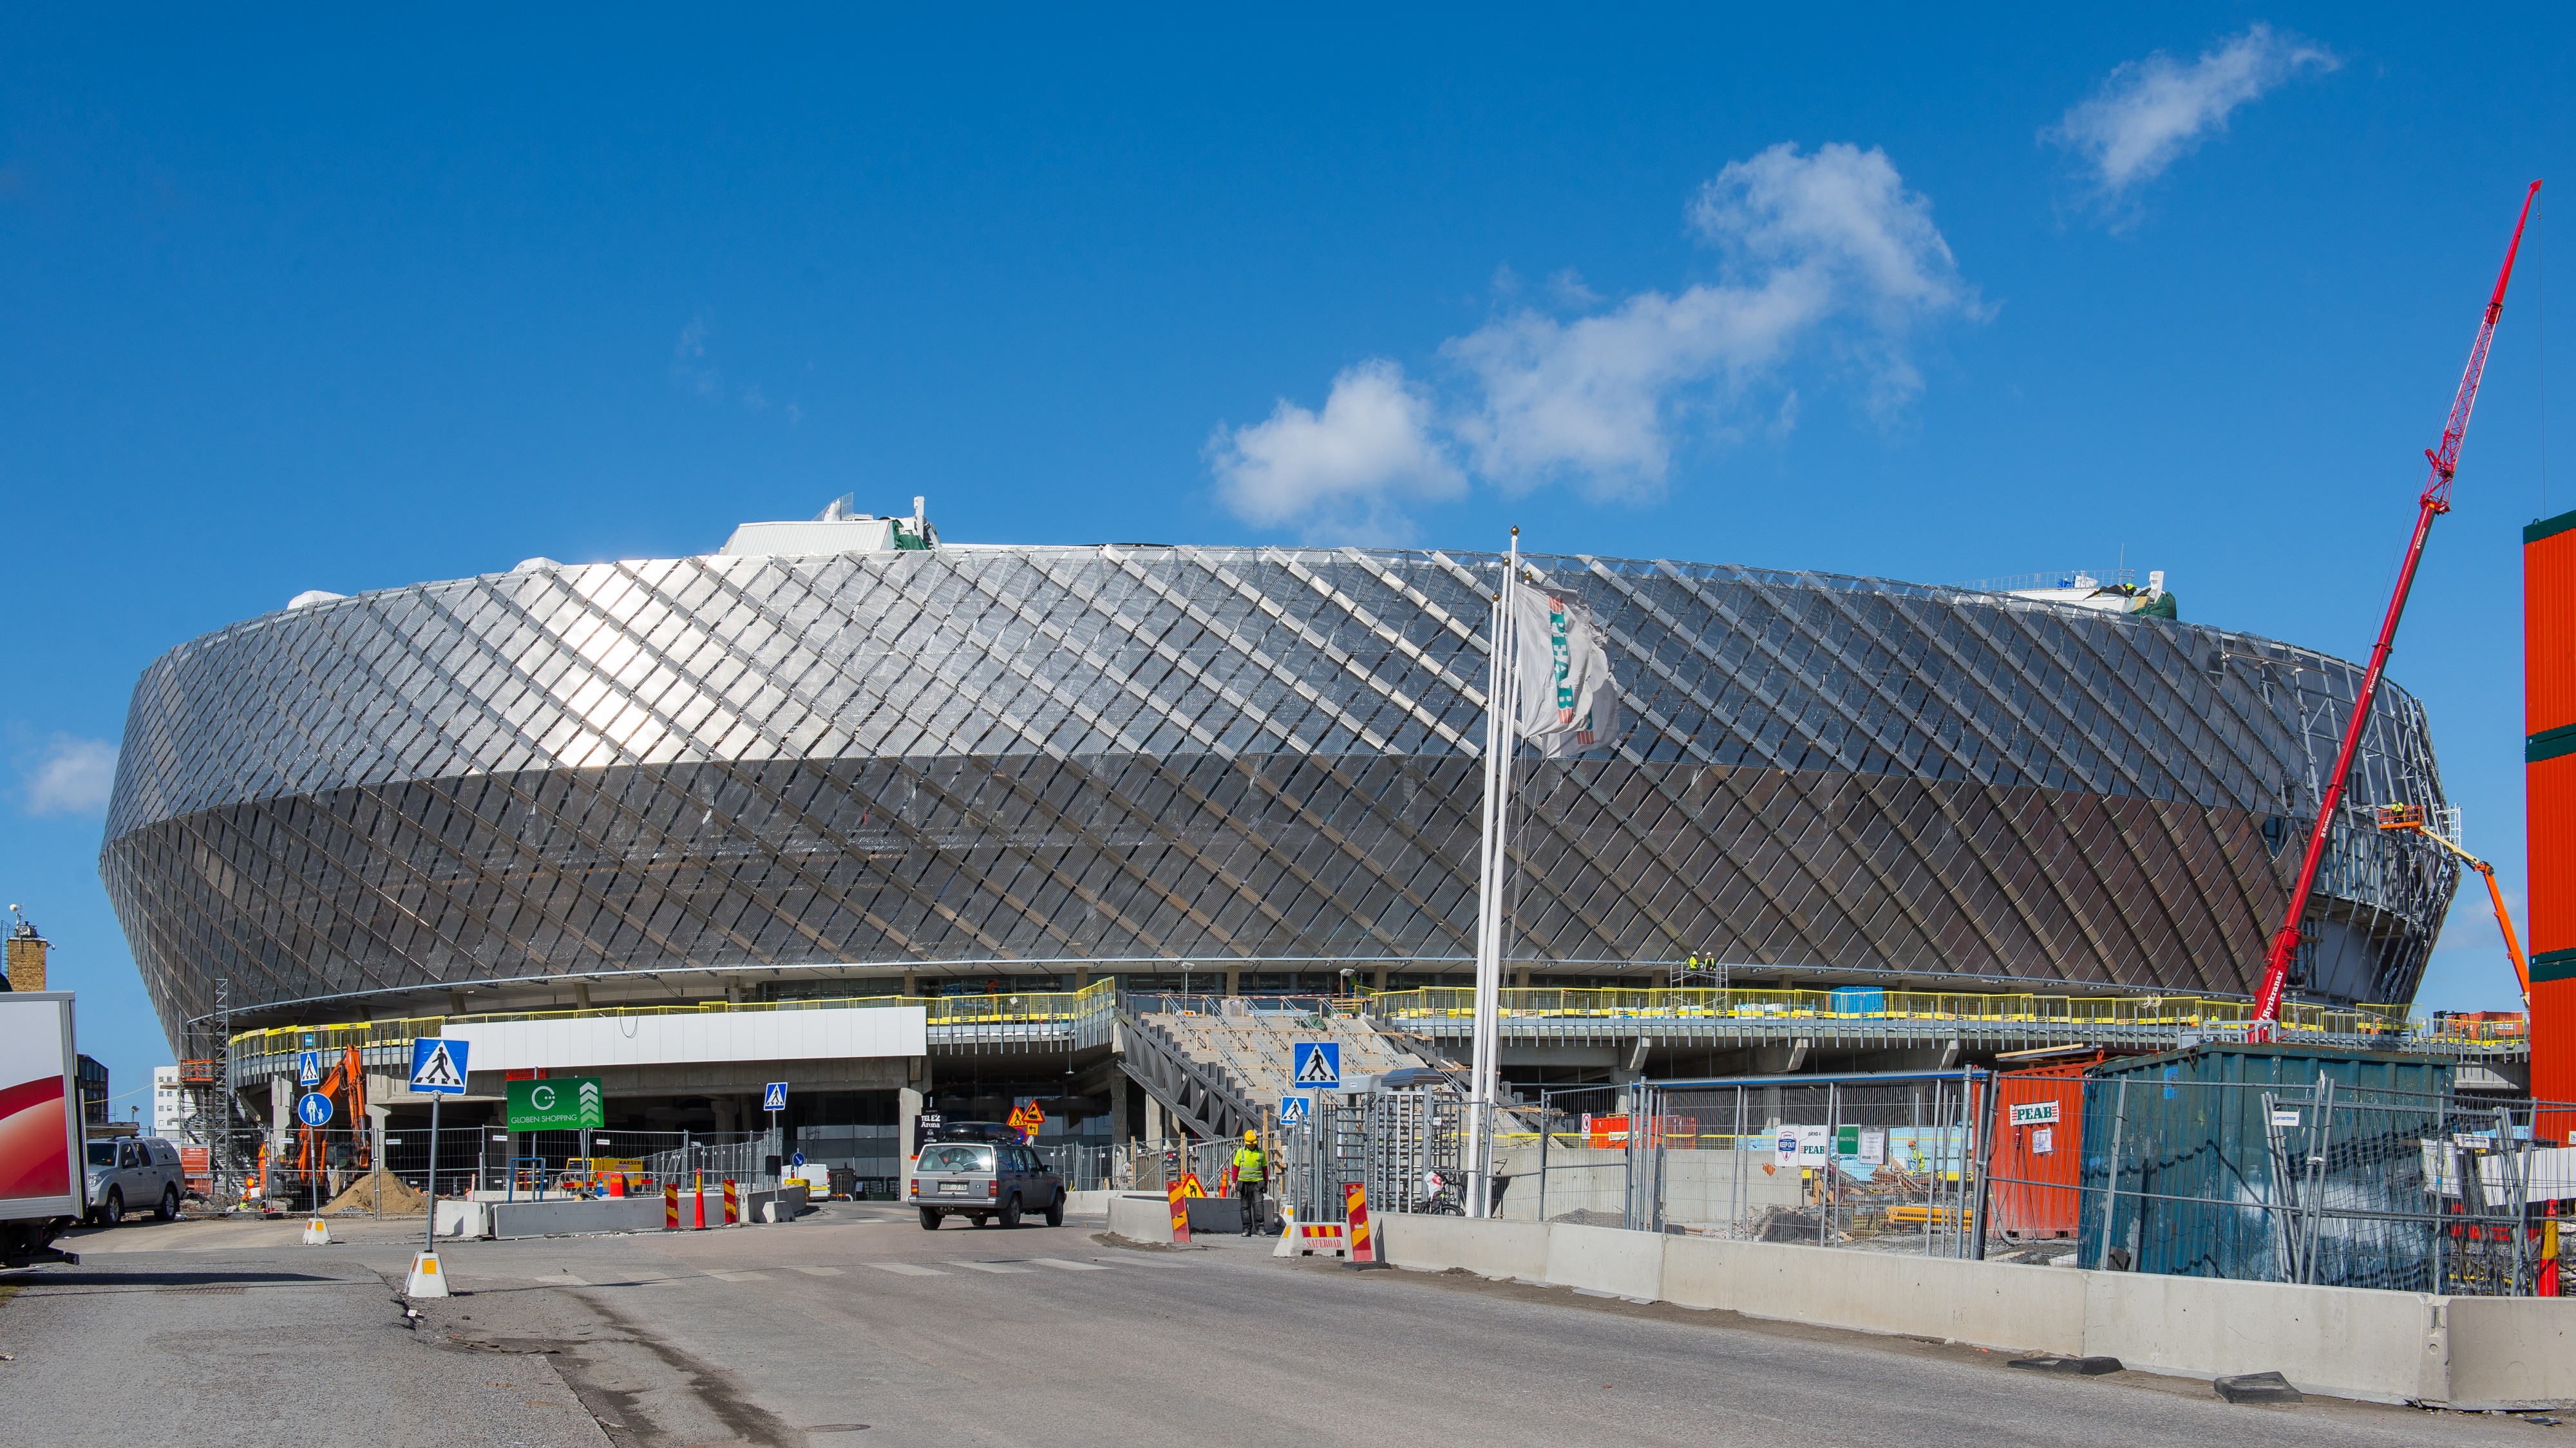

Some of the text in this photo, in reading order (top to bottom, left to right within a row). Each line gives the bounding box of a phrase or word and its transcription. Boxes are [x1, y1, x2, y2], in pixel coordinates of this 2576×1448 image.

[1549, 611, 1574, 709] PEAB
[2262, 970, 2283, 1019] Hyrkranar
[542, 1114, 578, 1122] SHOPPING
[2016, 1106, 2052, 1120] PEAB
[1803, 1145, 1824, 1154] PEAB
[1307, 1239, 1341, 1248] SAFEROAD
